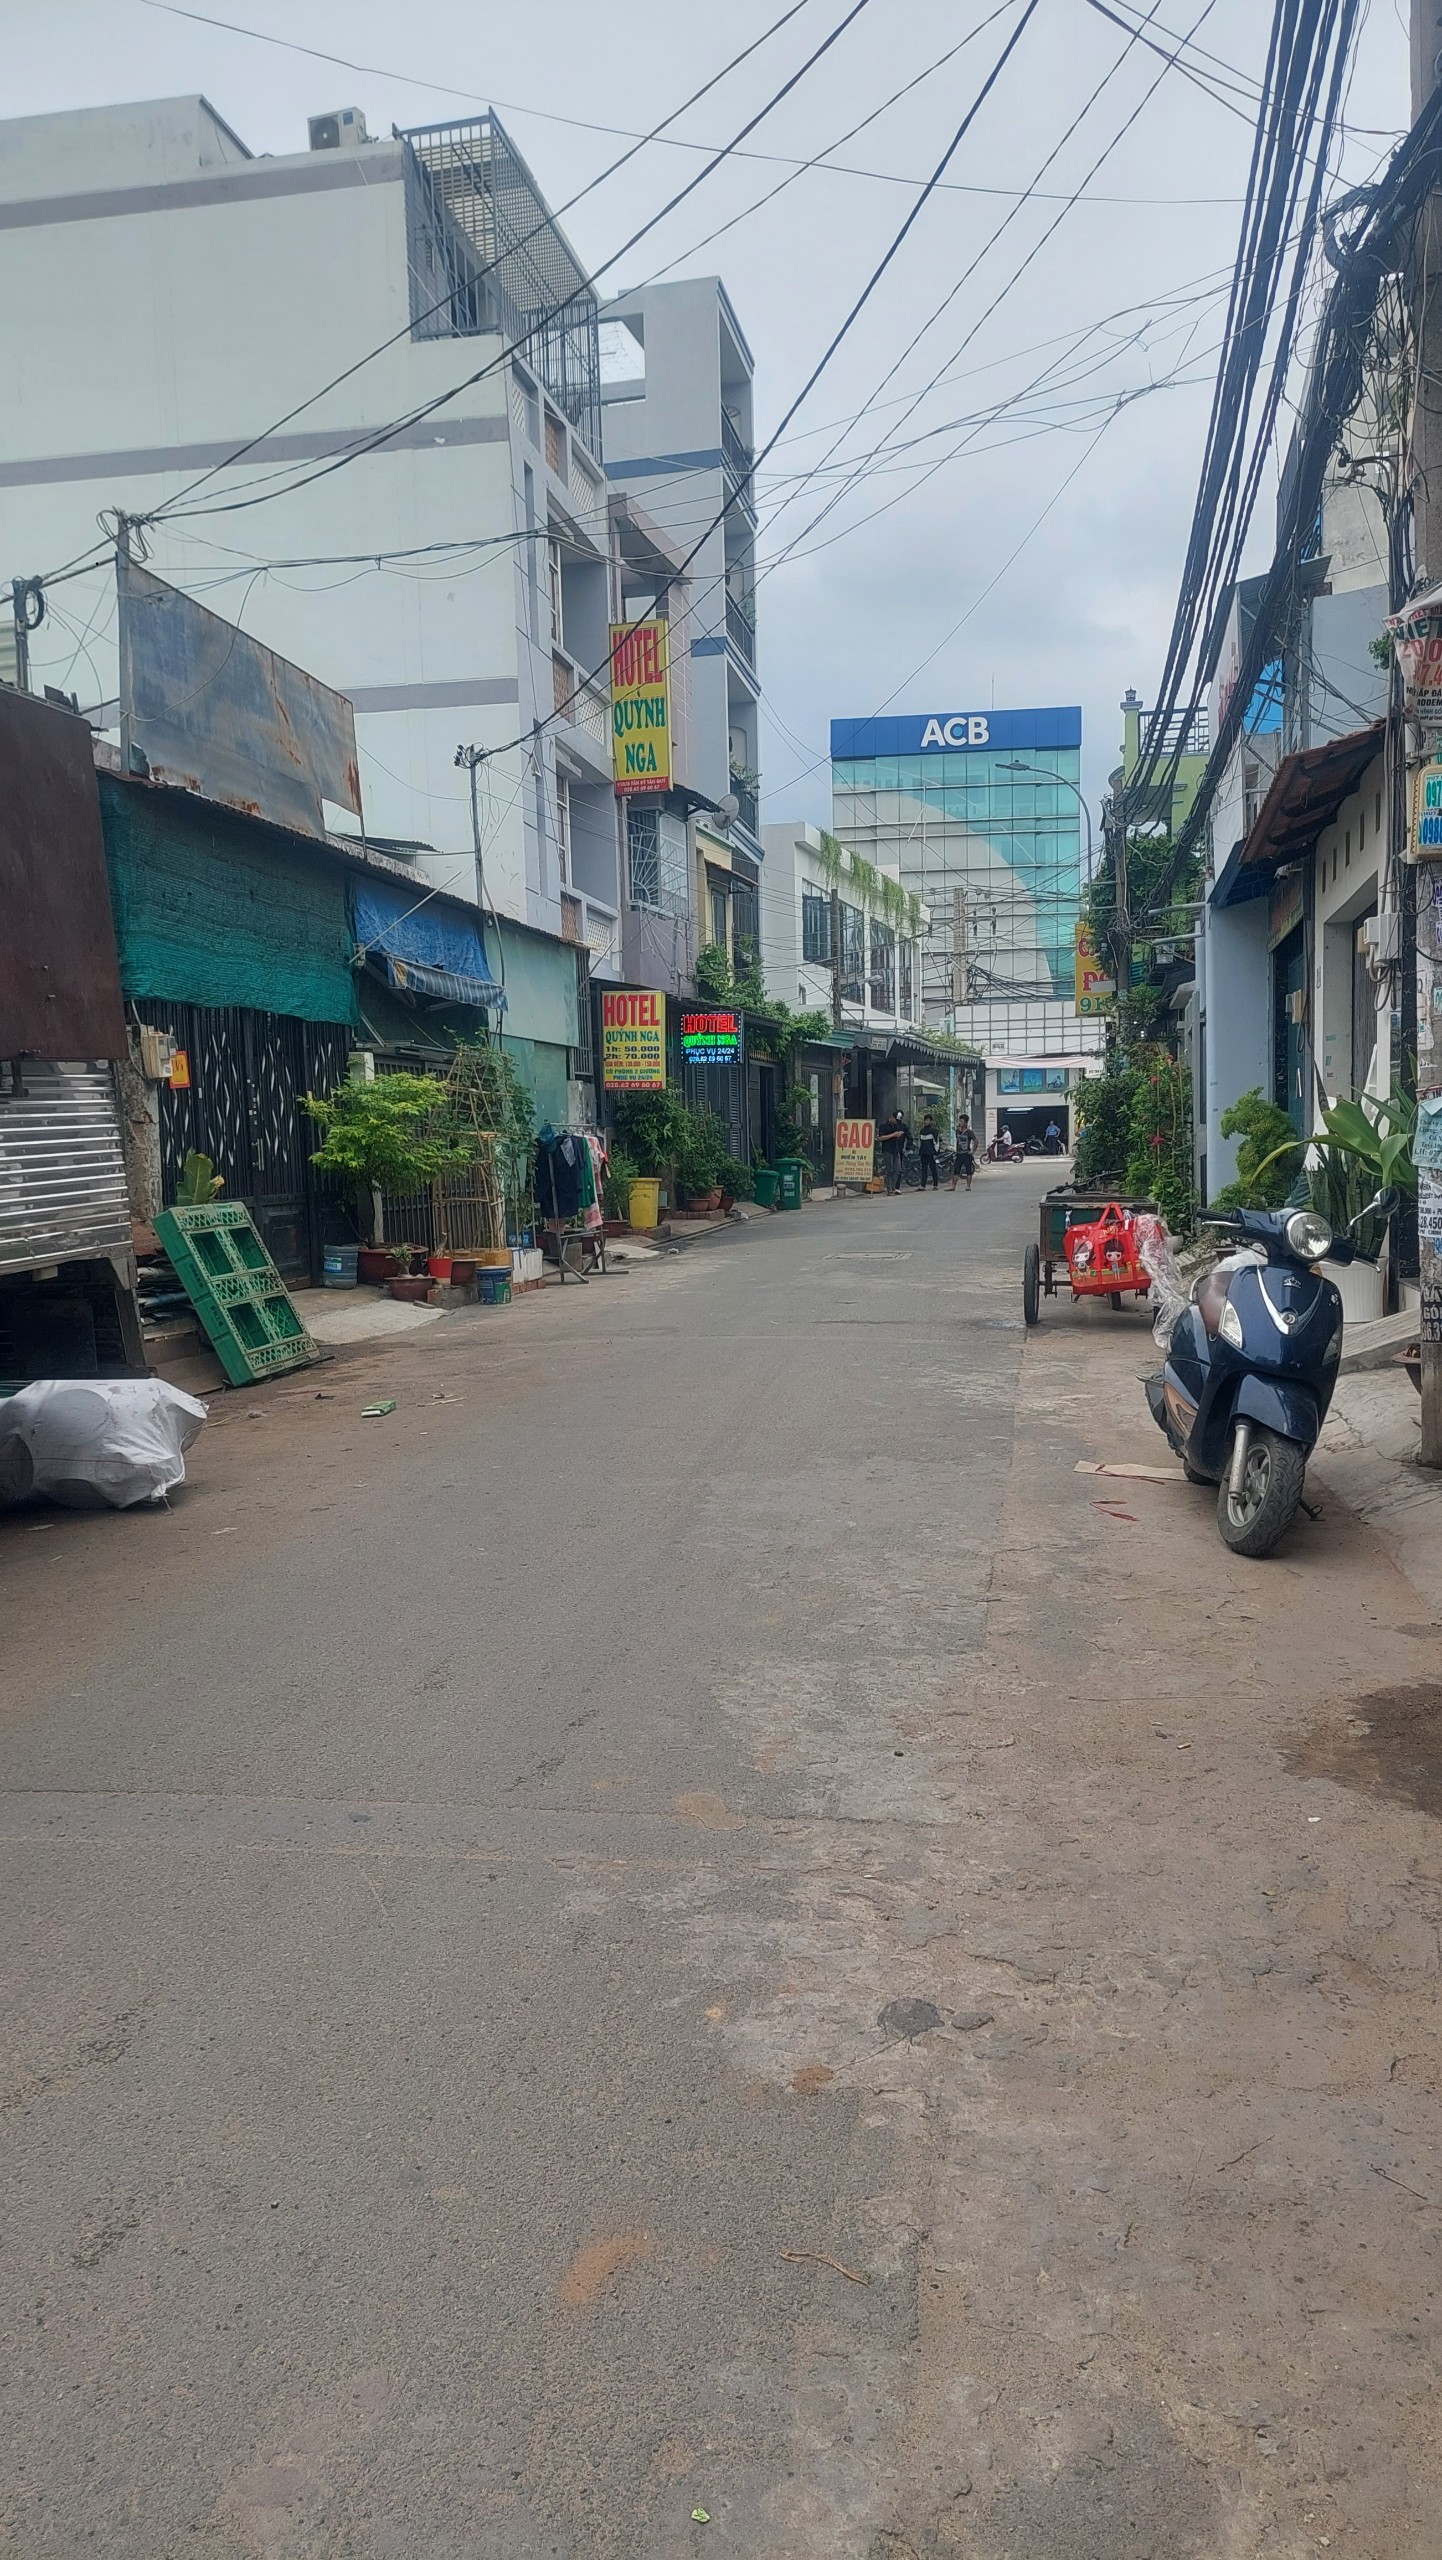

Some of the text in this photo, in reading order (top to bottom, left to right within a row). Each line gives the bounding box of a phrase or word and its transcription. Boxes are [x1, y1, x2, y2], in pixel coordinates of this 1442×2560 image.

[613, 627, 662, 687] HOTEL
[614, 691, 665, 738] QUỲNH
[920, 717, 989, 747] ACB
[625, 742, 657, 773] NGA
[604, 994, 660, 1026] HOTEL
[683, 1015, 738, 1033] HOTEL
[606, 1028, 659, 1044] QUỲNH NGA
[717, 1034, 738, 1046] NGA
